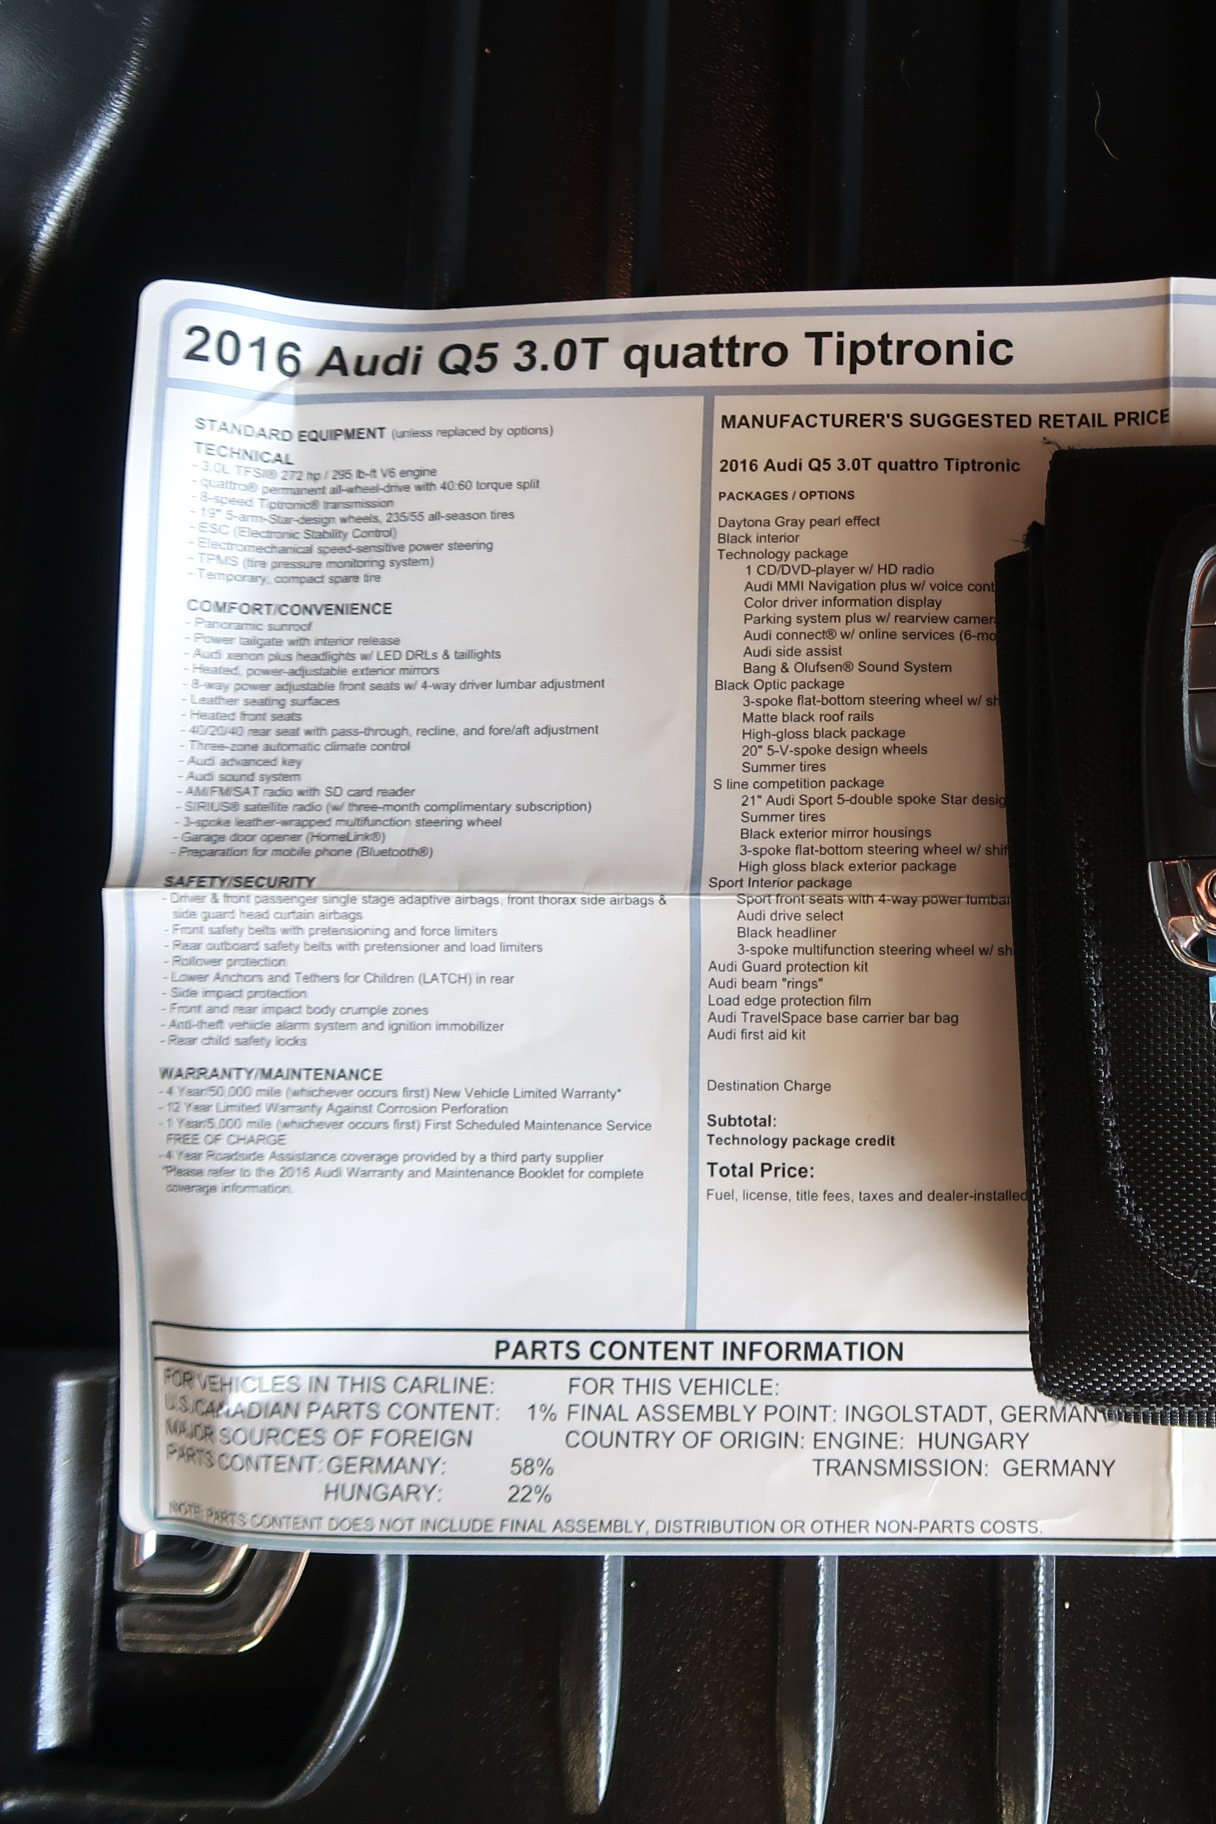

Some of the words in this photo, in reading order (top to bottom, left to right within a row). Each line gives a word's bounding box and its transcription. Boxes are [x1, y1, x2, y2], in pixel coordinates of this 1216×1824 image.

[184, 325, 301, 378] 2016
[315, 345, 423, 377] Audi
[438, 342, 499, 376] Q5
[513, 337, 609, 372] 3.0T
[624, 334, 788, 378] quattro
[804, 329, 1014, 375] Tiptronic
[721, 413, 903, 429] MANUFACTURER'S
[909, 413, 1032, 428] SUGGESTED
[1039, 413, 1108, 429] RETAIL
[1114, 407, 1169, 427] PRICE
[195, 417, 292, 442] STANDARD
[298, 427, 386, 442] EQUIPMENT
[392, 428, 433, 440] (unless
[436, 426, 486, 439] replaced
[489, 426, 504, 438] by
[506, 425, 554, 438] options)
[720, 459, 758, 472] 2016
[763, 458, 802, 472] Audi
[808, 458, 831, 472] Q5
[837, 457, 872, 471] 3.0T
[877, 458, 938, 474] quattro
[943, 458, 1020, 475] Tiptronic
[718, 490, 788, 501] PACKAGES
[799, 490, 855, 500] OPTIONS
[718, 516, 771, 530] Daytona
[775, 516, 805, 530] Gray
[809, 516, 841, 530] pearl
[845, 515, 880, 527] effect
[717, 548, 791, 562] Technology
[794, 548, 848, 562] package
[743, 662, 776, 676] Bang
[858, 661, 899, 672] Sound
[904, 660, 952, 675] System
[339, 680, 366, 691] front
[369, 681, 401, 691] seats
[404, 681, 418, 690] w/
[421, 680, 456, 693] 4-way
[459, 679, 493, 690] driver
[496, 679, 537, 690] lumbar
[540, 679, 605, 691] adjustment
[163, 876, 319, 890] SAFETY/SECURITY
[707, 1079, 779, 1091] Destination
[784, 1080, 831, 1095] Charge
[707, 1114, 776, 1127] Subtotal:
[226, 1134, 287, 1146] CHARGE
[707, 1134, 788, 1149] Technology
[792, 1134, 850, 1149] package
[855, 1135, 895, 1146] credit
[706, 1162, 753, 1178] Total
[760, 1162, 814, 1178] Price:
[495, 1340, 580, 1360] PARTS
[590, 1340, 714, 1361] CONTENT
[722, 1341, 903, 1361] INFORMATION
[308, 1376, 329, 1393] IN
[337, 1375, 386, 1394] THIS
[393, 1376, 494, 1394] CARLINE:
[569, 1377, 614, 1395] FOR
[622, 1378, 671, 1396] THIS
[678, 1378, 779, 1396] VEHICLE:
[528, 1403, 557, 1422] 1%
[567, 1404, 629, 1422] FINAL
[636, 1404, 757, 1422] ASSEMBLY
[764, 1404, 836, 1422] POINT:
[846, 1404, 992, 1425] INGOLSTADT,
[1001, 1405, 1108, 1423] GERMAN
[333, 1428, 364, 1447] OF
[370, 1429, 472, 1447] FOREIGN
[565, 1430, 676, 1448] COUNTRY
[682, 1430, 713, 1449] OF
[720, 1431, 804, 1449] ORIGIN:
[814, 1432, 904, 1450] ENGINE:
[918, 1432, 1029, 1450] HUNGARY
[327, 1456, 446, 1475] GERMANY:
[510, 1457, 554, 1476] 58%
[812, 1458, 988, 1477] TRANSMISSION:
[1003, 1458, 1116, 1477] GERMANY
[324, 1483, 442, 1502] HUNGARY:
[508, 1484, 552, 1504] 22%
[250, 1513, 323, 1530] CONTENT
[328, 1517, 374, 1532] DOES
[379, 1517, 415, 1532] NOT
[420, 1518, 493, 1533] INCLUDE
[499, 1518, 546, 1533] FINAL
[552, 1519, 648, 1536] ASSEMBLY,
[655, 1519, 775, 1534] DISTRIBUTION
[780, 1520, 805, 1534] OR
[810, 1519, 869, 1534] OTHER
[875, 1520, 975, 1534] NON-PARTS
[980, 1519, 1043, 1534] COSTS.
